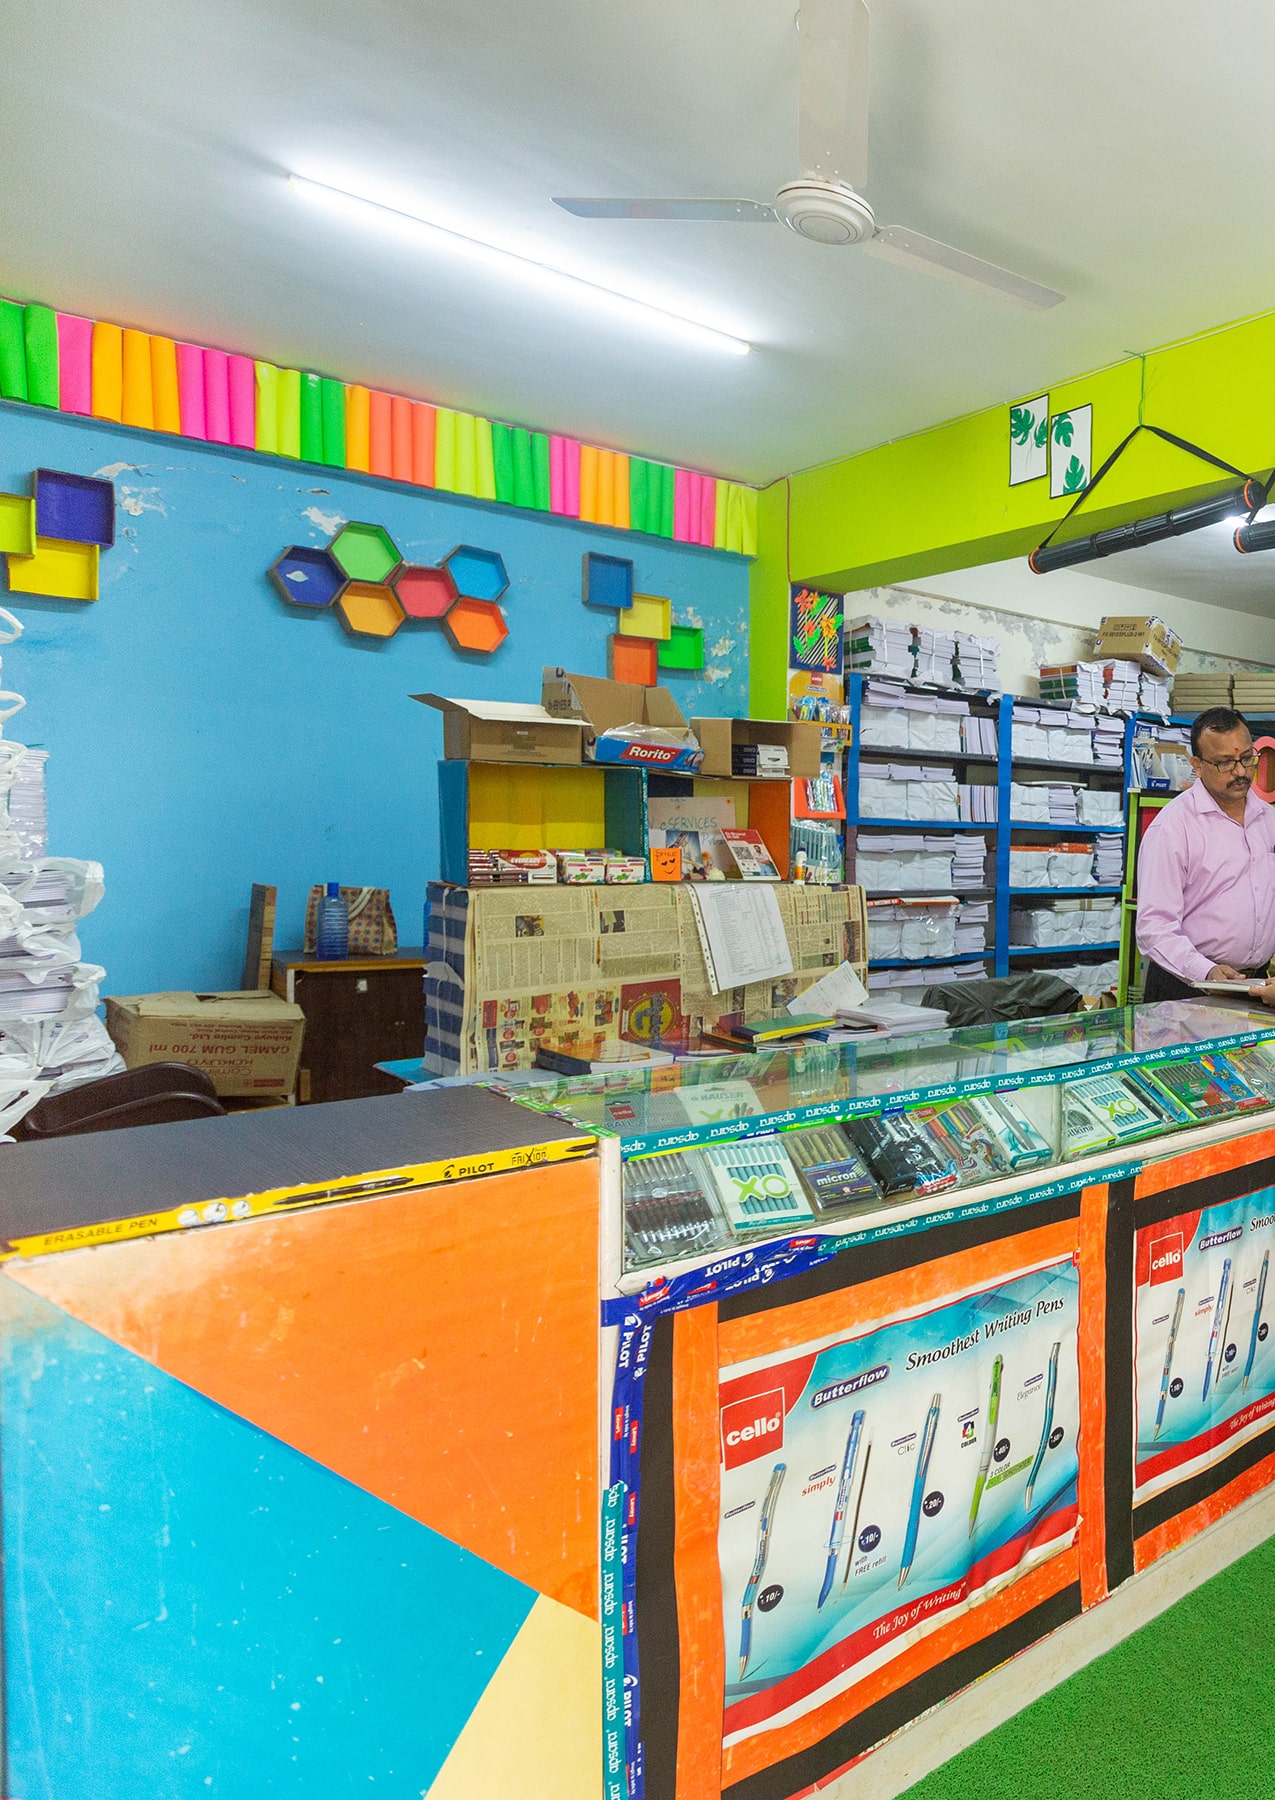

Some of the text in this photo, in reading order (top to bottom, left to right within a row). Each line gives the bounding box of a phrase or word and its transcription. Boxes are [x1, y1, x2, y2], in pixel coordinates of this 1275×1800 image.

[628, 743, 671, 761] Rorito
[149, 1044, 290, 1054] CAMEL GUM 700 ml
[1194, 1042, 1214, 1053] apsara
[1218, 1037, 1237, 1048] apsara
[1145, 1051, 1167, 1063] apsara
[1170, 1046, 1191, 1058] apsara
[1091, 1061, 1114, 1074] apsara
[1118, 1055, 1141, 1067] apsara
[998, 1075, 1025, 1087] apsara
[1031, 1072, 1055, 1084] apsara
[1061, 1067, 1086, 1080] apsara
[927, 1086, 957, 1098] apsara
[964, 1080, 992, 1092] apsara
[700, 1090, 747, 1101] HAUSER
[889, 1091, 920, 1104] apsara
[805, 1103, 841, 1118] apsara
[848, 1098, 881, 1111] apsara
[1098, 1098, 1138, 1120] XO
[759, 1112, 797, 1127] apsara
[710, 1122, 750, 1138] apsara
[657, 1132, 700, 1149] apsara
[458, 1162, 495, 1176] PILOT
[1102, 1169, 1125, 1182] apsara
[816, 1170, 857, 1186] micron
[732, 1174, 790, 1202] XO
[1029, 1188, 1054, 1202] apsara
[996, 1195, 1022, 1210] apsara
[926, 1210, 954, 1225] apsara
[962, 1203, 989, 1218] apsara
[43, 1217, 159, 1247] ERASABLE PEN
[874, 1218, 904, 1235] apsara
[1200, 1228, 1242, 1250] Butterflow
[704, 1257, 741, 1278] PILOT
[1152, 1250, 1182, 1270] cello
[906, 1297, 1064, 1371] Smoothest Writing Pens
[618, 1331, 635, 1369] PILOT
[635, 1324, 652, 1363] PILOT
[813, 1366, 888, 1407] Butterflow
[725, 1416, 781, 1447] cello
[897, 1442, 916, 1456] Clic
[960, 1437, 977, 1449] COLOUR
[801, 1475, 836, 1497] simply
[603, 1520, 617, 1562] apsara
[855, 1555, 868, 1567] with
[855, 1556, 887, 1577] FREE refill
[603, 1573, 617, 1616] apsara
[872, 1624, 891, 1640] The
[891, 1611, 909, 1632] Joy
[910, 1604, 922, 1619] of
[603, 1625, 618, 1669] apsara
[605, 1678, 620, 1722] apsara
[606, 1730, 622, 1774] apsara
